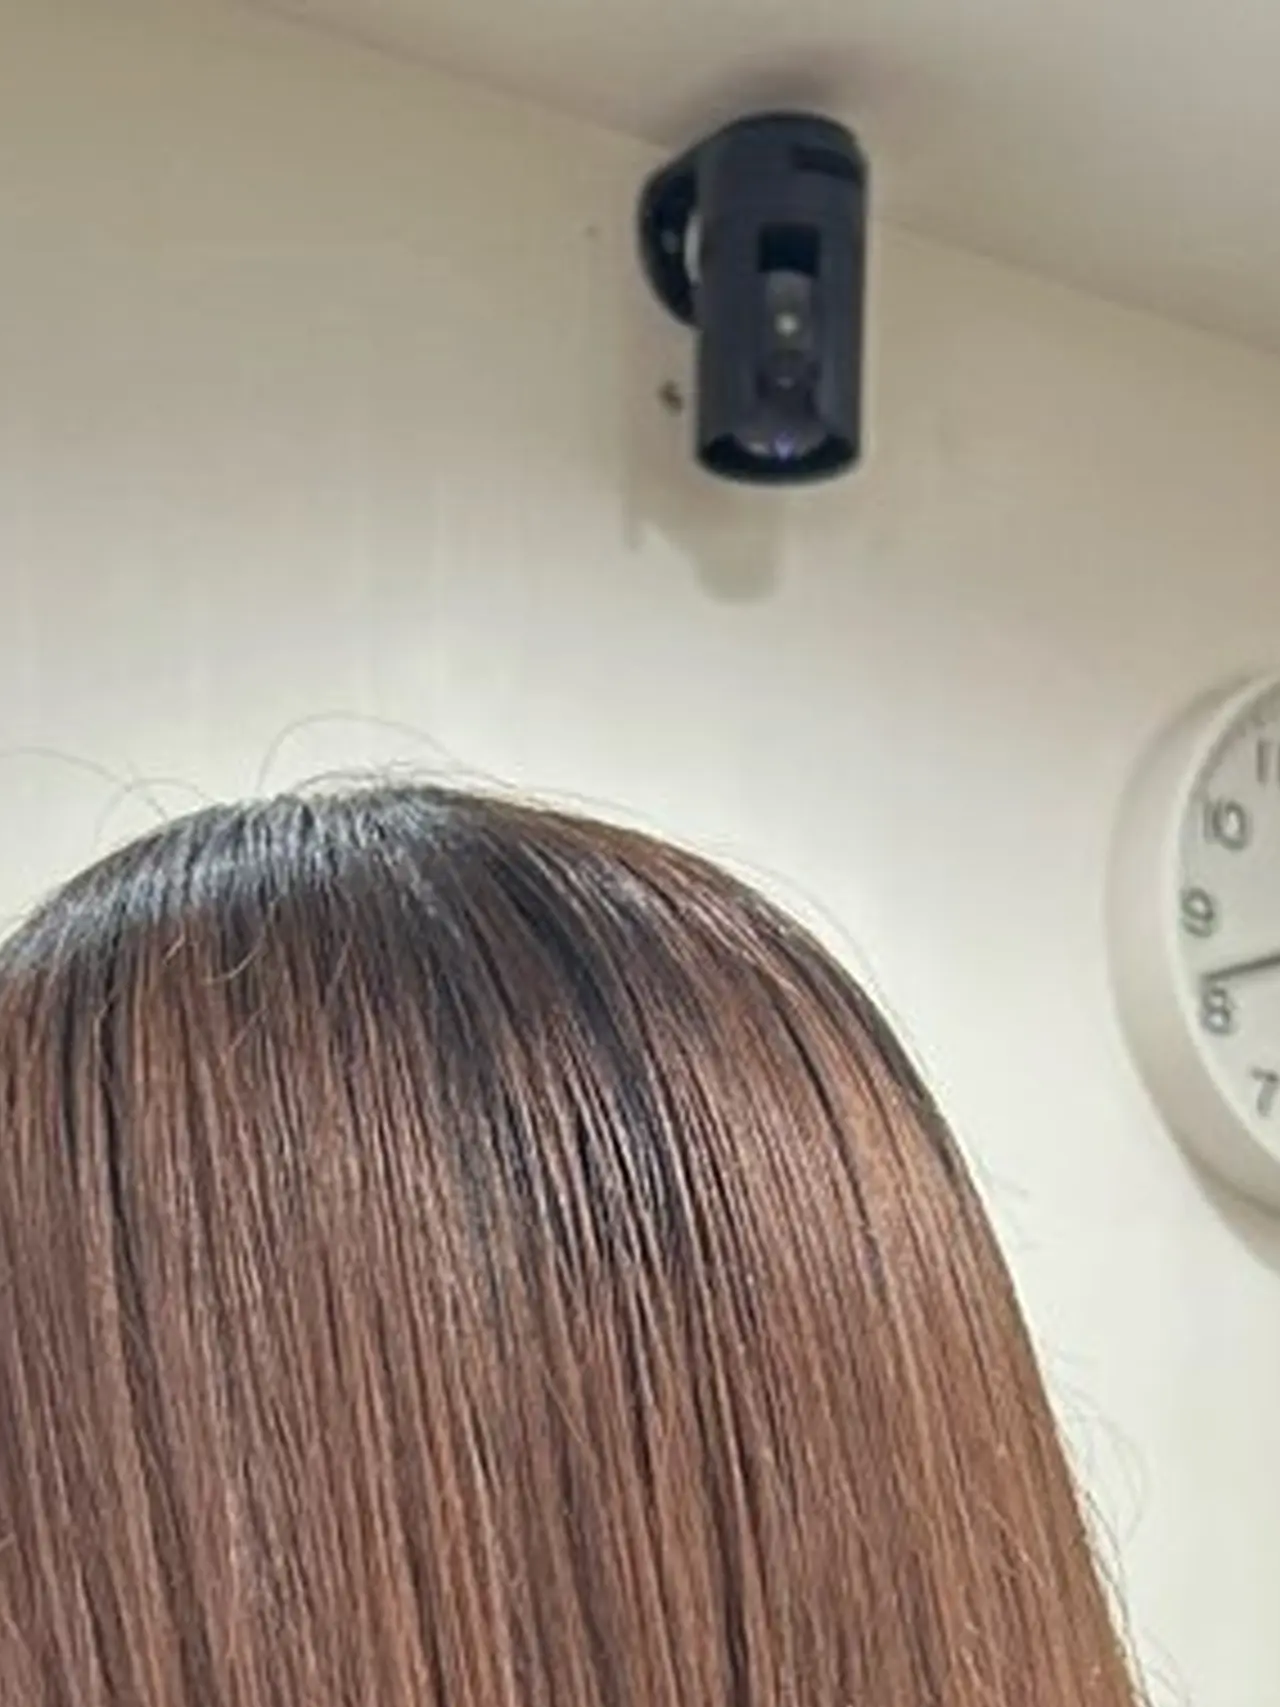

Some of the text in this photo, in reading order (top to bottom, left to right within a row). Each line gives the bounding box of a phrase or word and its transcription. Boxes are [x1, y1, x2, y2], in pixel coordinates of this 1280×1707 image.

[1202, 800, 1250, 851] 10
[1183, 889, 1215, 937] 9
[1200, 983, 1235, 1036] 8
[1250, 1067, 1280, 1116] 7
